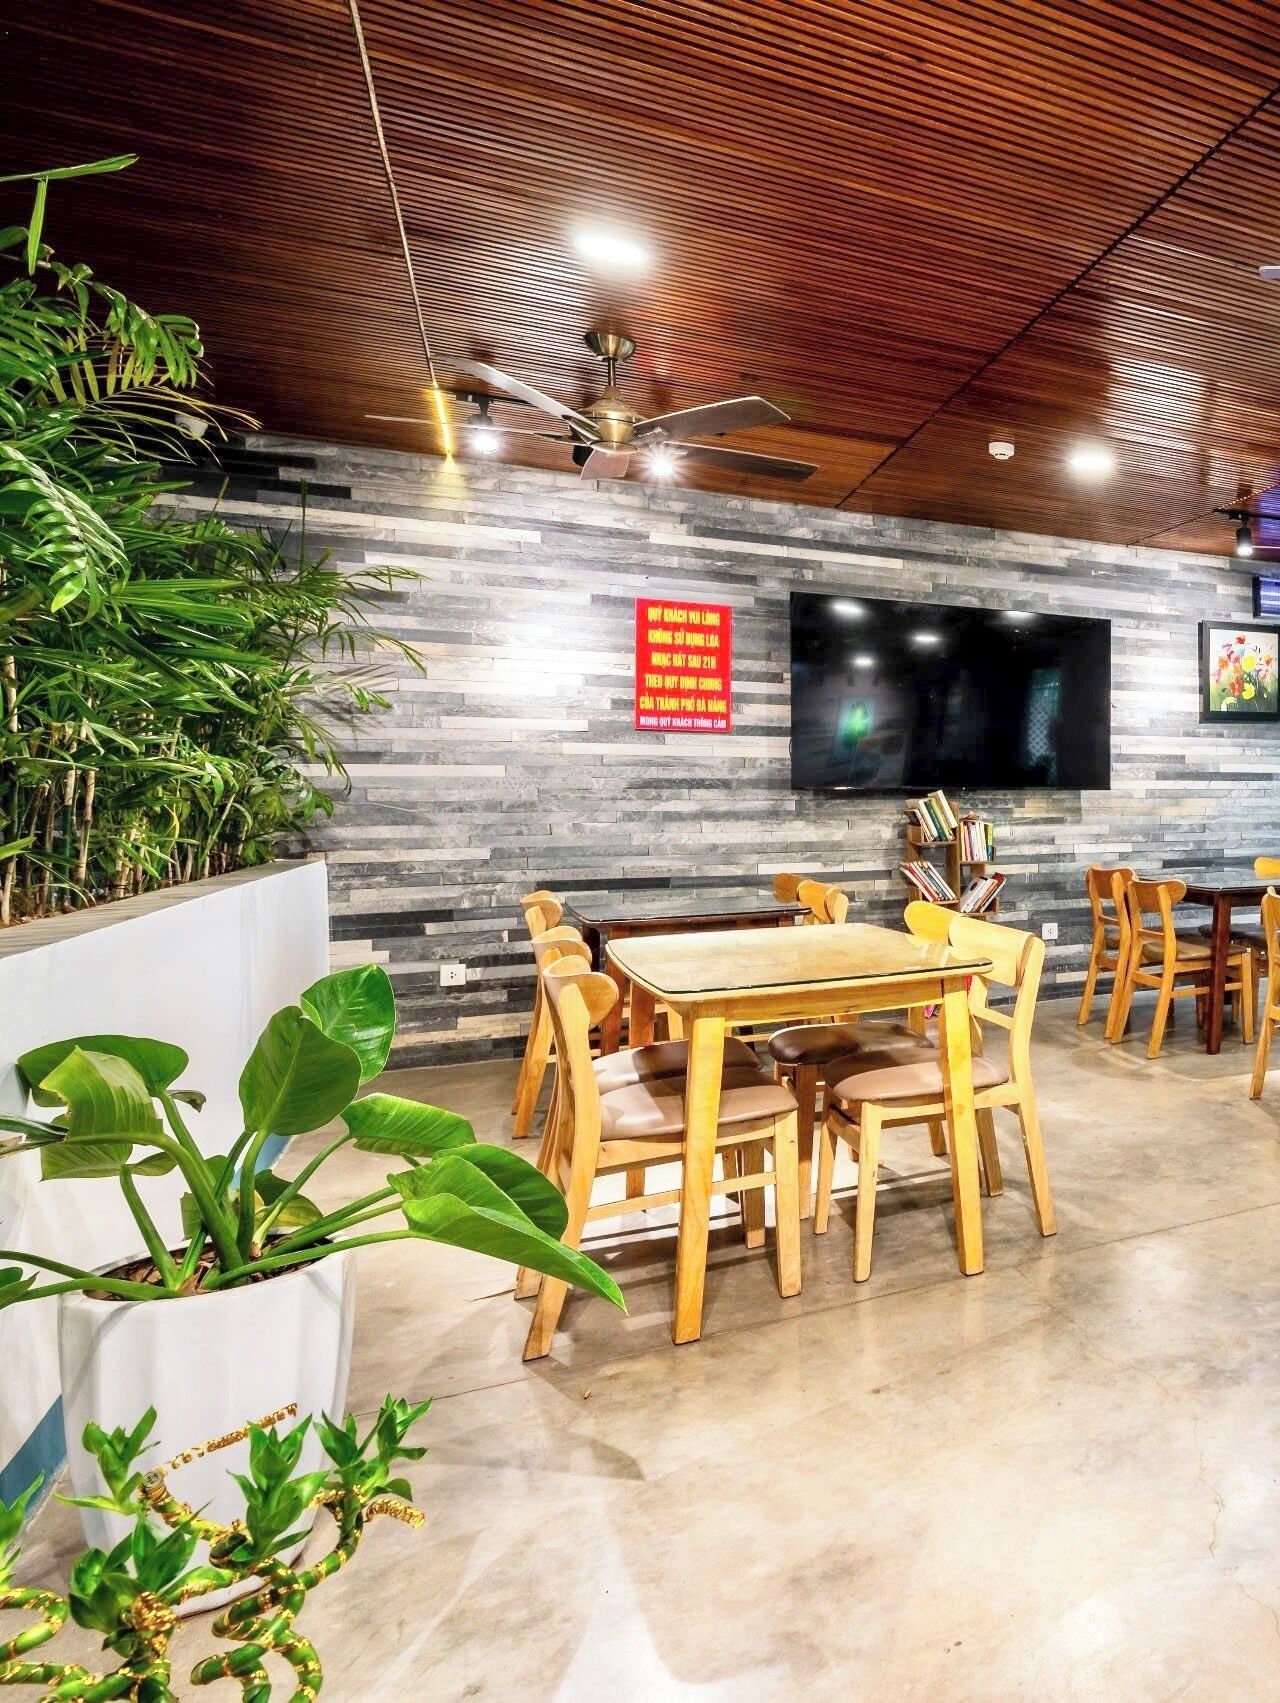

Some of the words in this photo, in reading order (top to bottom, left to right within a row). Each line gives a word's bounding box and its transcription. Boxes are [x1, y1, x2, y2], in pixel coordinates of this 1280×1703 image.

[663, 607, 687, 623] KHÁCH
[688, 610, 701, 625] VUI
[701, 609, 720, 626] LÒNG
[647, 627, 673, 645] KHÔNG
[685, 631, 705, 648] DỤNG
[705, 633, 720, 648] LOA
[687, 654, 701, 669] SAU
[702, 655, 717, 670] 21H
[645, 673, 663, 688] THEO
[679, 675, 697, 692] ĐỊNH
[698, 677, 722, 692] CHUNG
[639, 692, 654, 710] CỦA
[655, 693, 680, 711] THÀNH
[680, 694, 695, 712] PHỐ
[640, 716, 658, 726] MONG
[672, 716, 692, 728] KHÁCH
[693, 717, 713, 728] THÔNG
